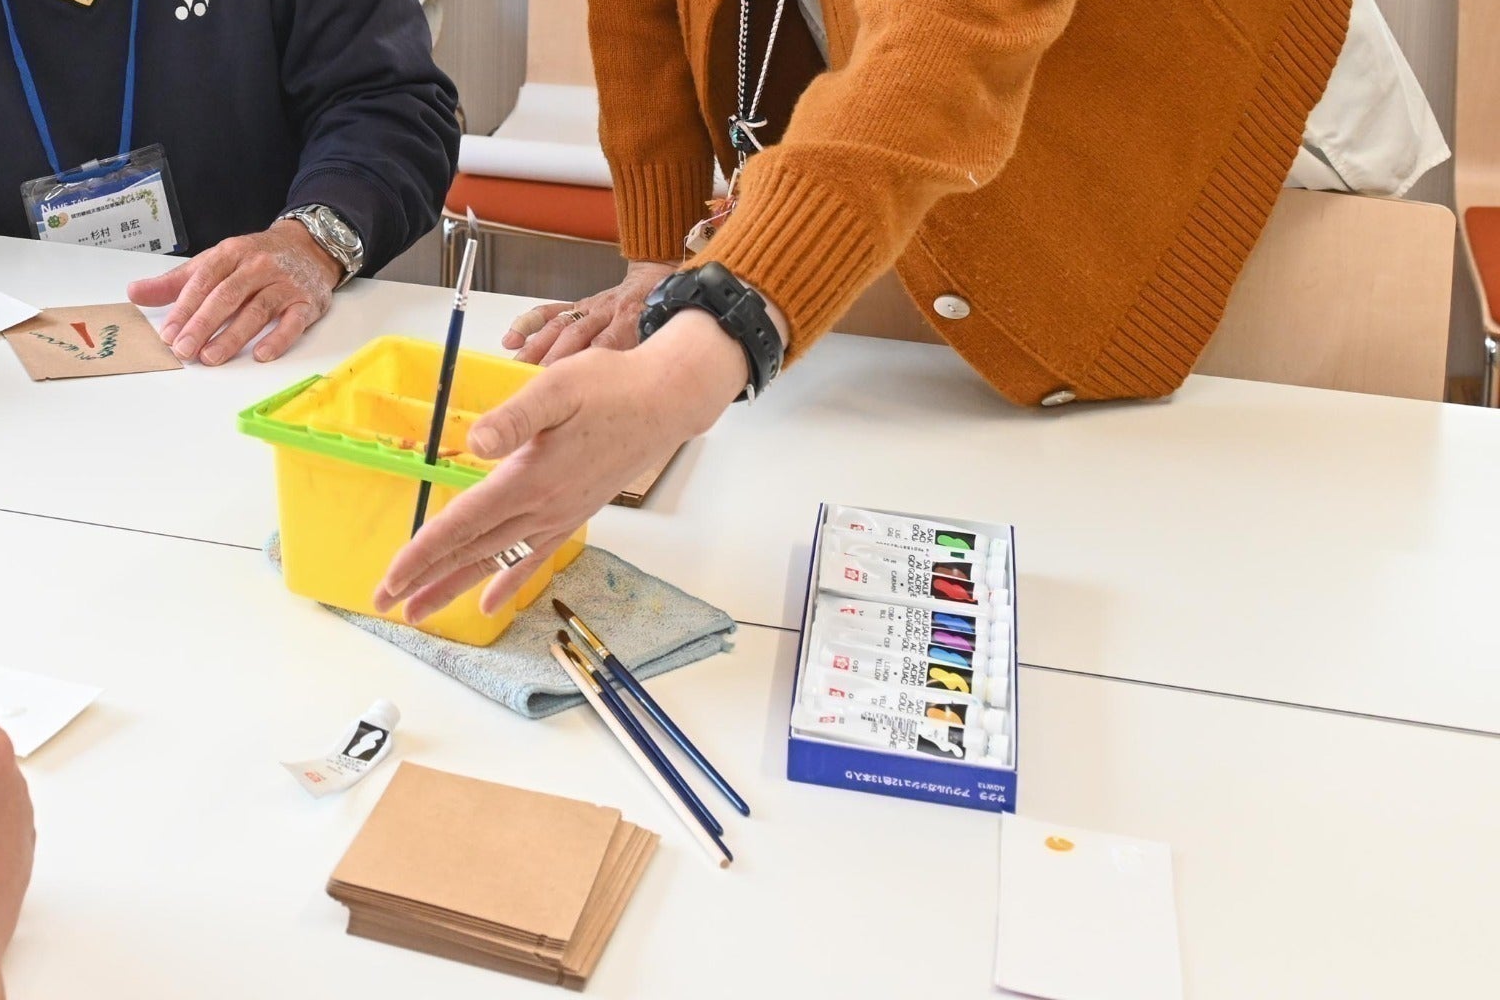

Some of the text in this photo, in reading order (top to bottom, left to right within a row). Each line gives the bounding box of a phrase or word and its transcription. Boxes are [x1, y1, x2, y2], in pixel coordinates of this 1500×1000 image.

[90, 219, 140, 240] 杉村 昌宏
[979, 792, 1007, 803] サクラ
